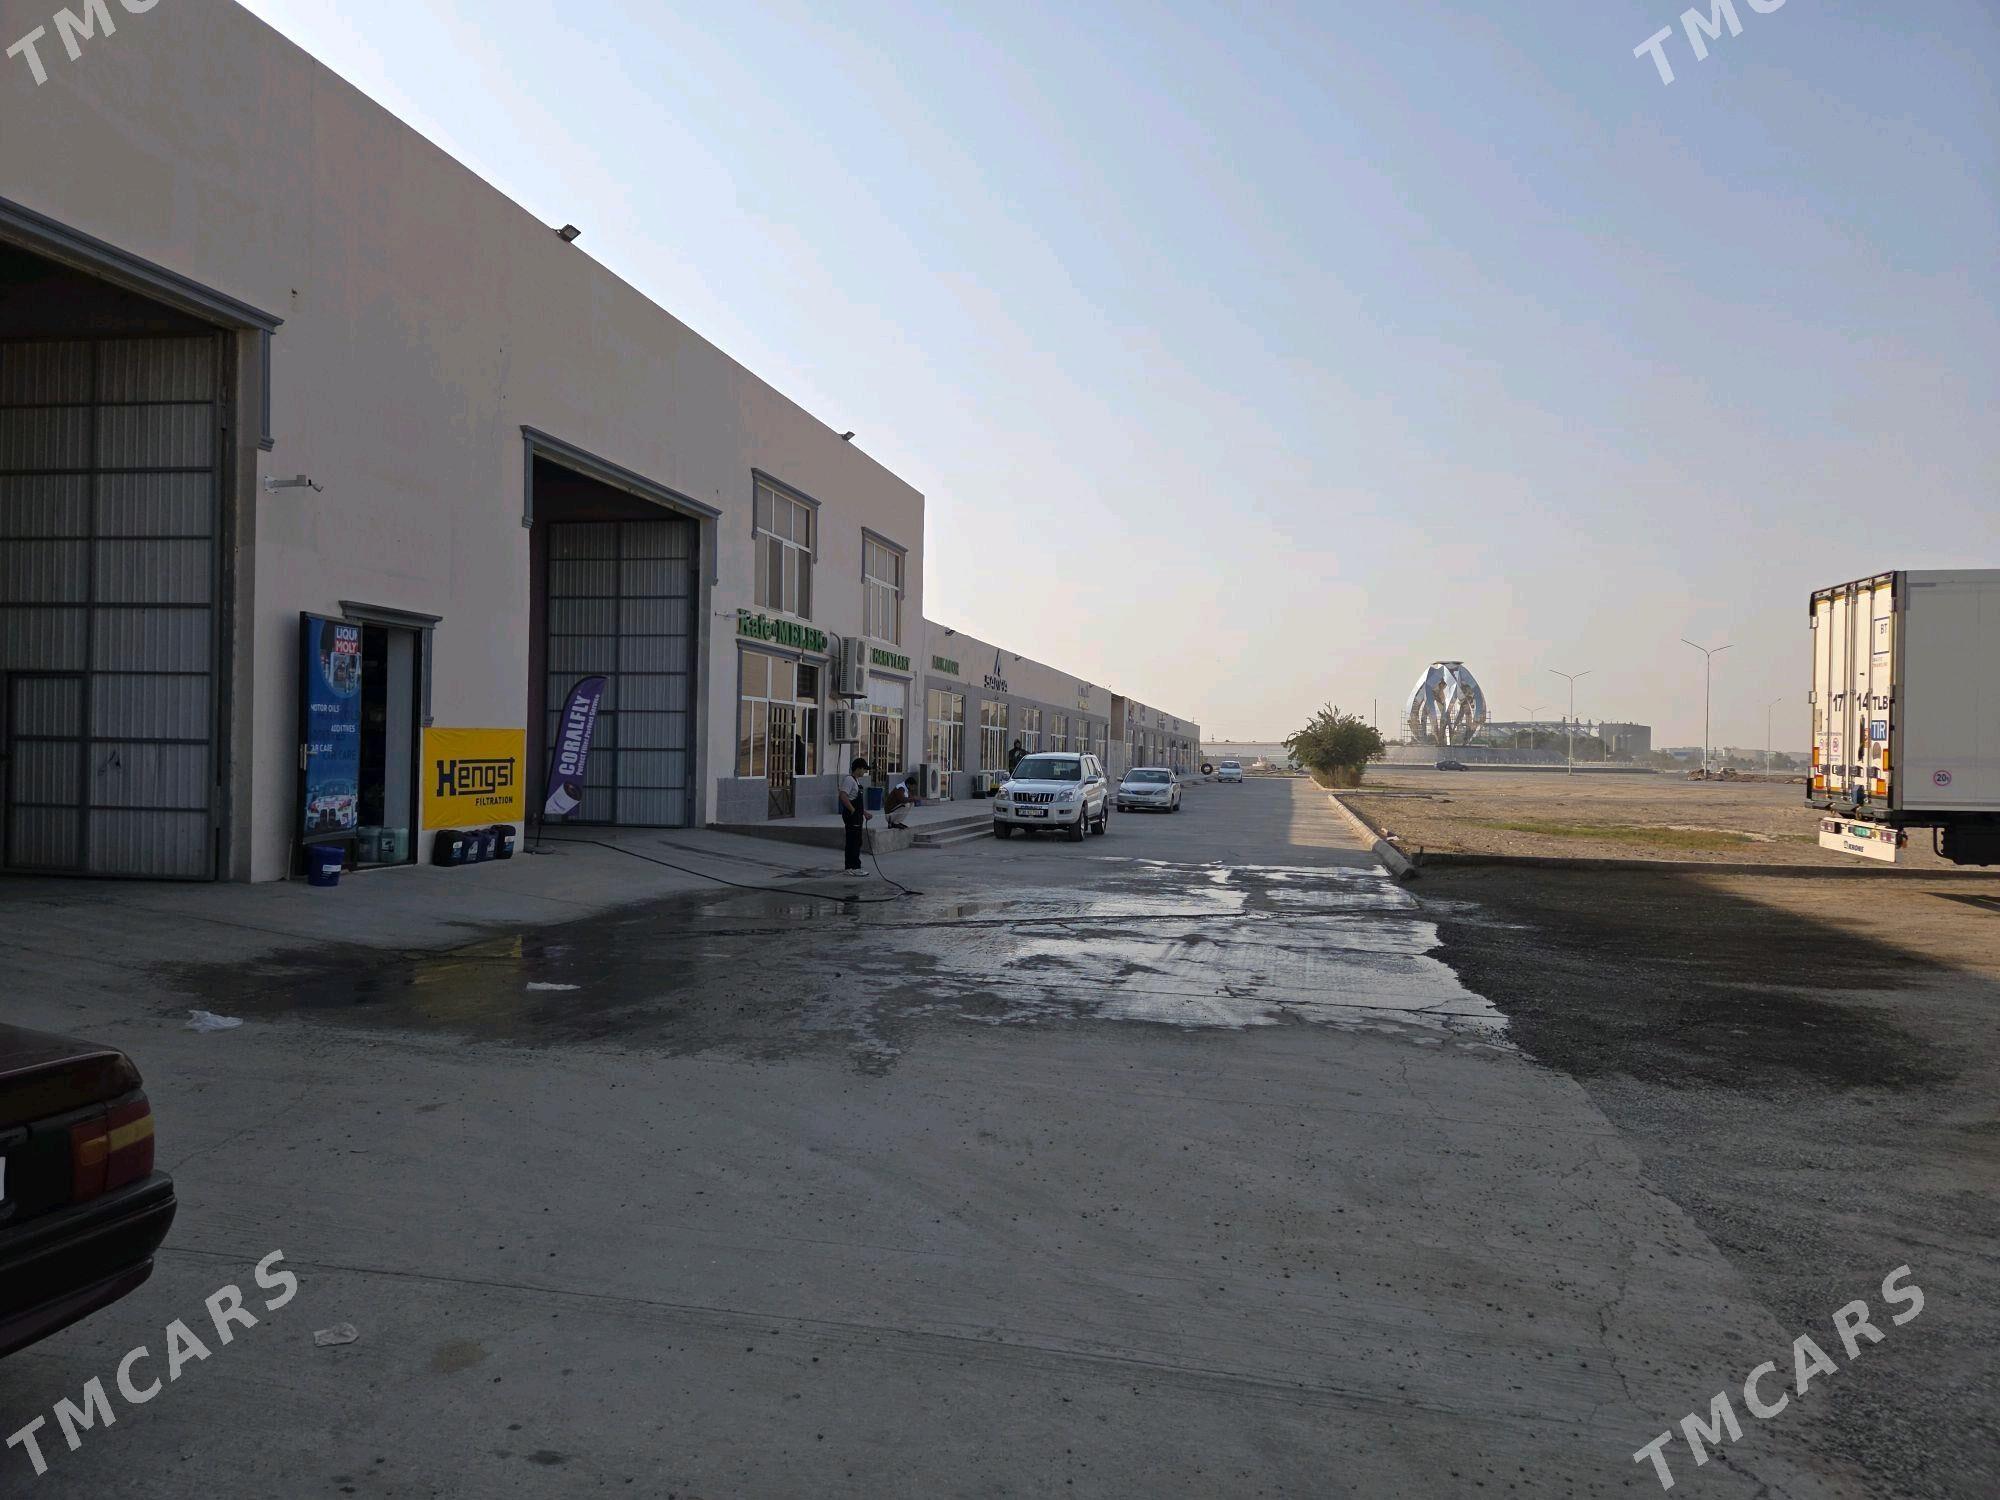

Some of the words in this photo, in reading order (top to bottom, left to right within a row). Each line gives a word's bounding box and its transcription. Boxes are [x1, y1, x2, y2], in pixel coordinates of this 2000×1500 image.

[336, 640, 357, 654] MOLY
[1833, 693, 1845, 712] 17
[558, 694, 591, 775] CORALFLY
[1871, 721, 1886, 739] TIR
[436, 756, 515, 797] Hengst
[475, 796, 513, 807] FILTRATION
